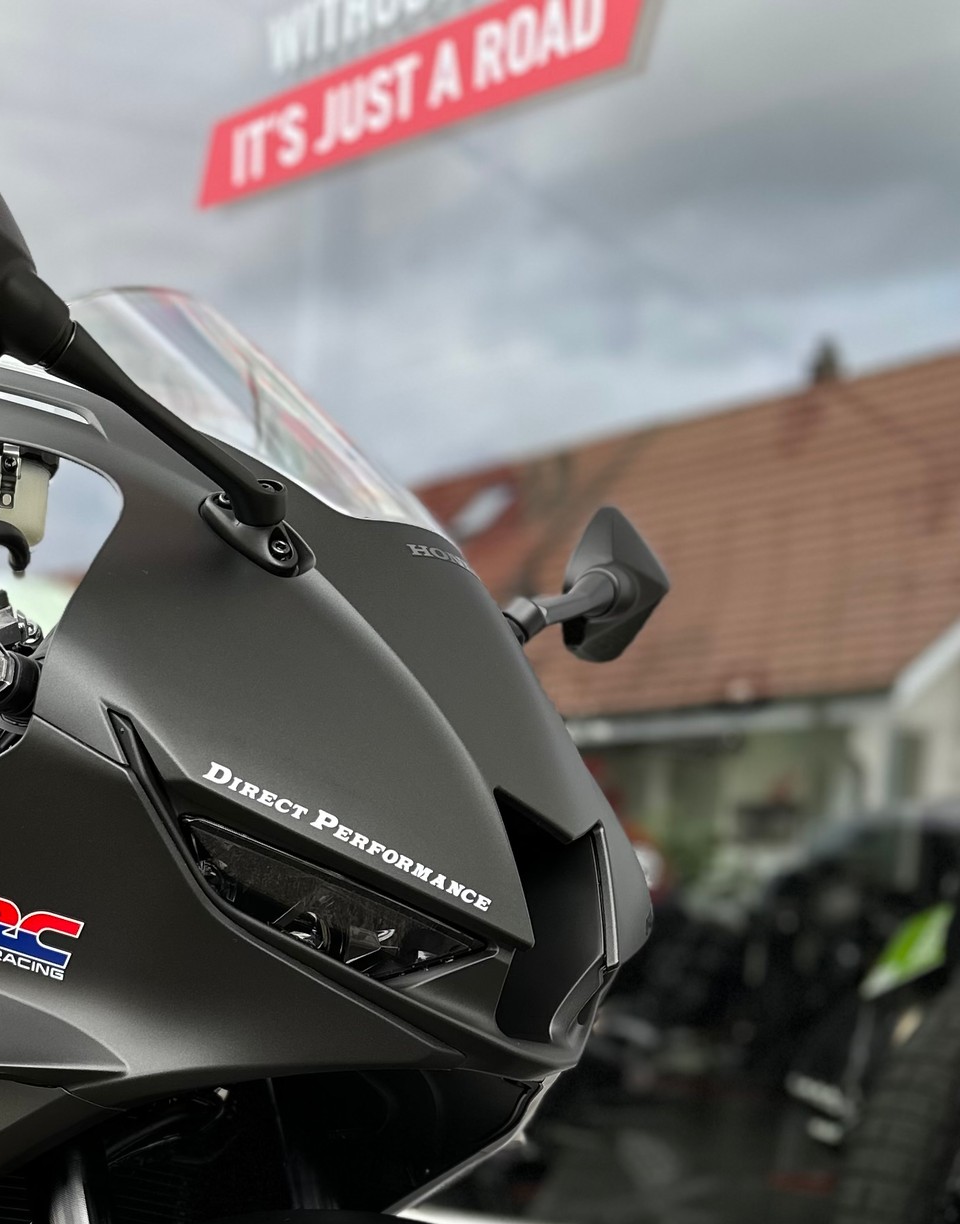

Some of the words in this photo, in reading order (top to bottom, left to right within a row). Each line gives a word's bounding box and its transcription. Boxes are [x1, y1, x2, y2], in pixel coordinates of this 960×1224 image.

[269, 0, 428, 73] WITH
[230, 103, 308, 188] IT'S
[314, 53, 421, 155] JUST
[427, 38, 462, 108] A
[473, 0, 606, 90] ROAD
[406, 543, 470, 569] HON
